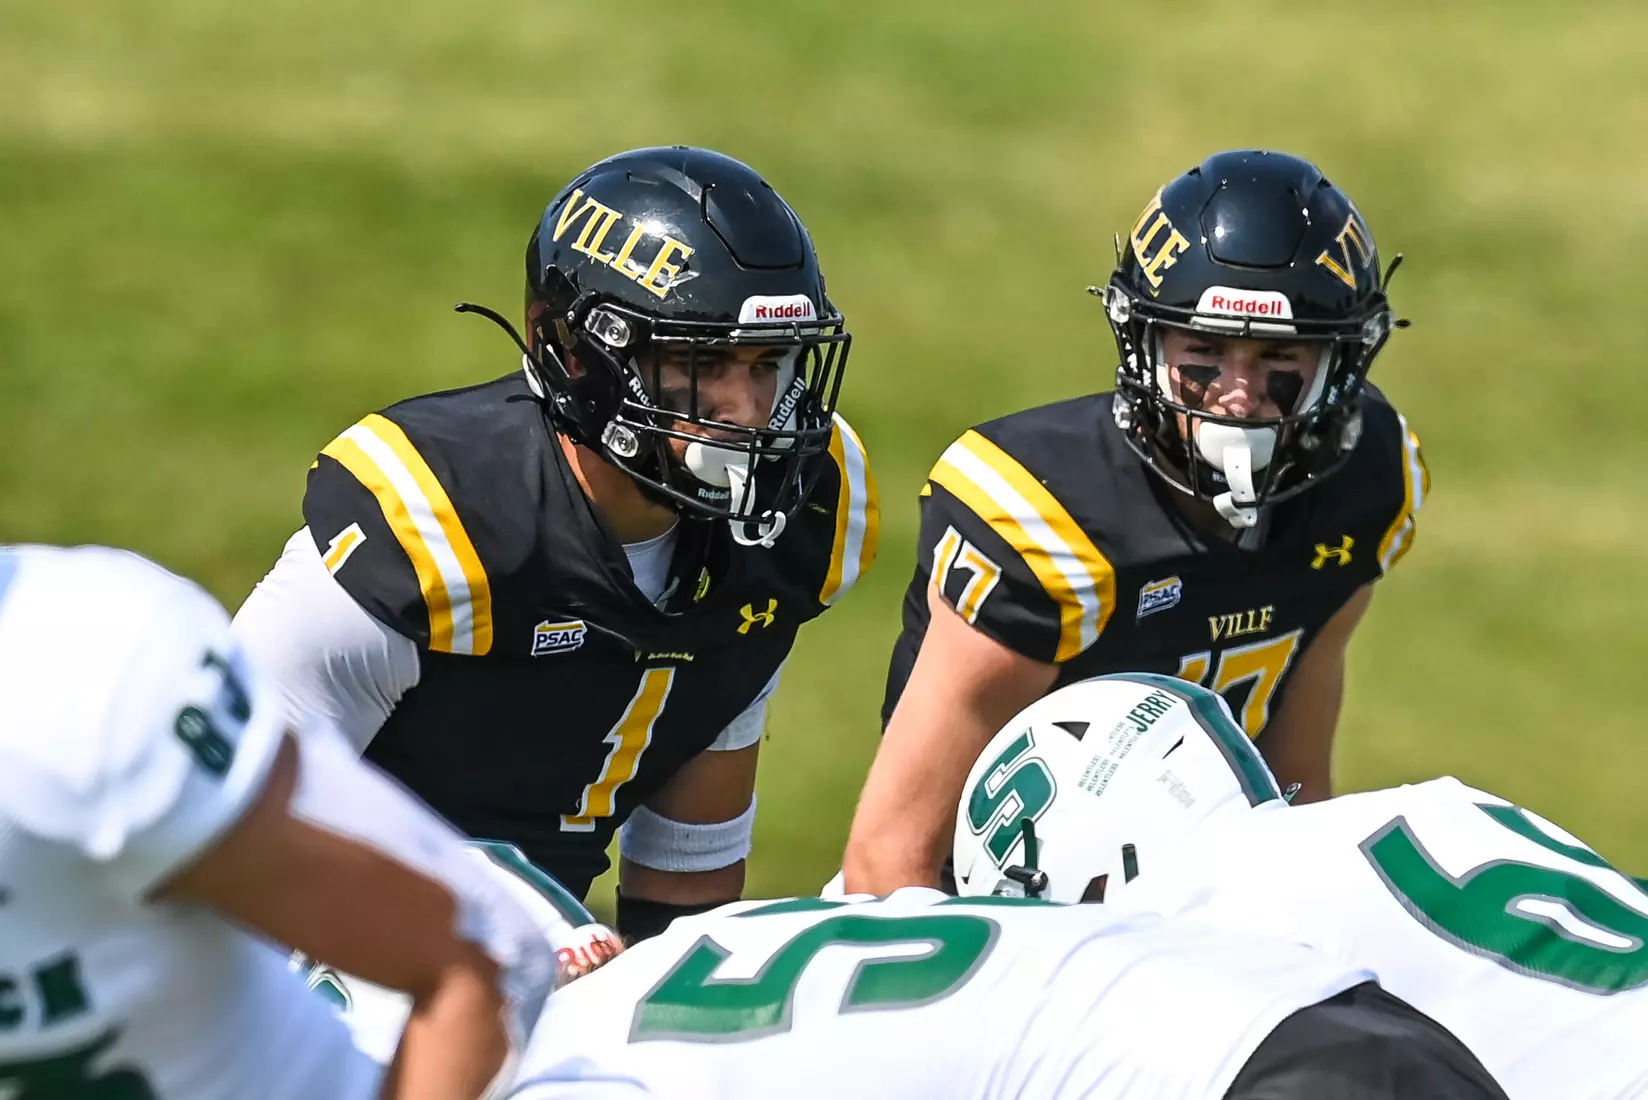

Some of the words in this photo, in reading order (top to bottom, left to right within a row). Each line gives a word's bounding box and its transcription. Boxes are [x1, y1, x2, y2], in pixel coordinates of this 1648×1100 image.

[552, 188, 696, 300] VILLE
[755, 301, 811, 319] Riddell
[1211, 295, 1283, 315] Riddell
[767, 376, 806, 431] Riddell
[697, 487, 730, 500] Riddell
[933, 524, 1003, 625] 17
[535, 629, 583, 649] PSAC
[173, 646, 252, 776] 87
[1126, 690, 1177, 733] JERRY
[1176, 628, 1304, 741] 7
[560, 667, 676, 833] 1
